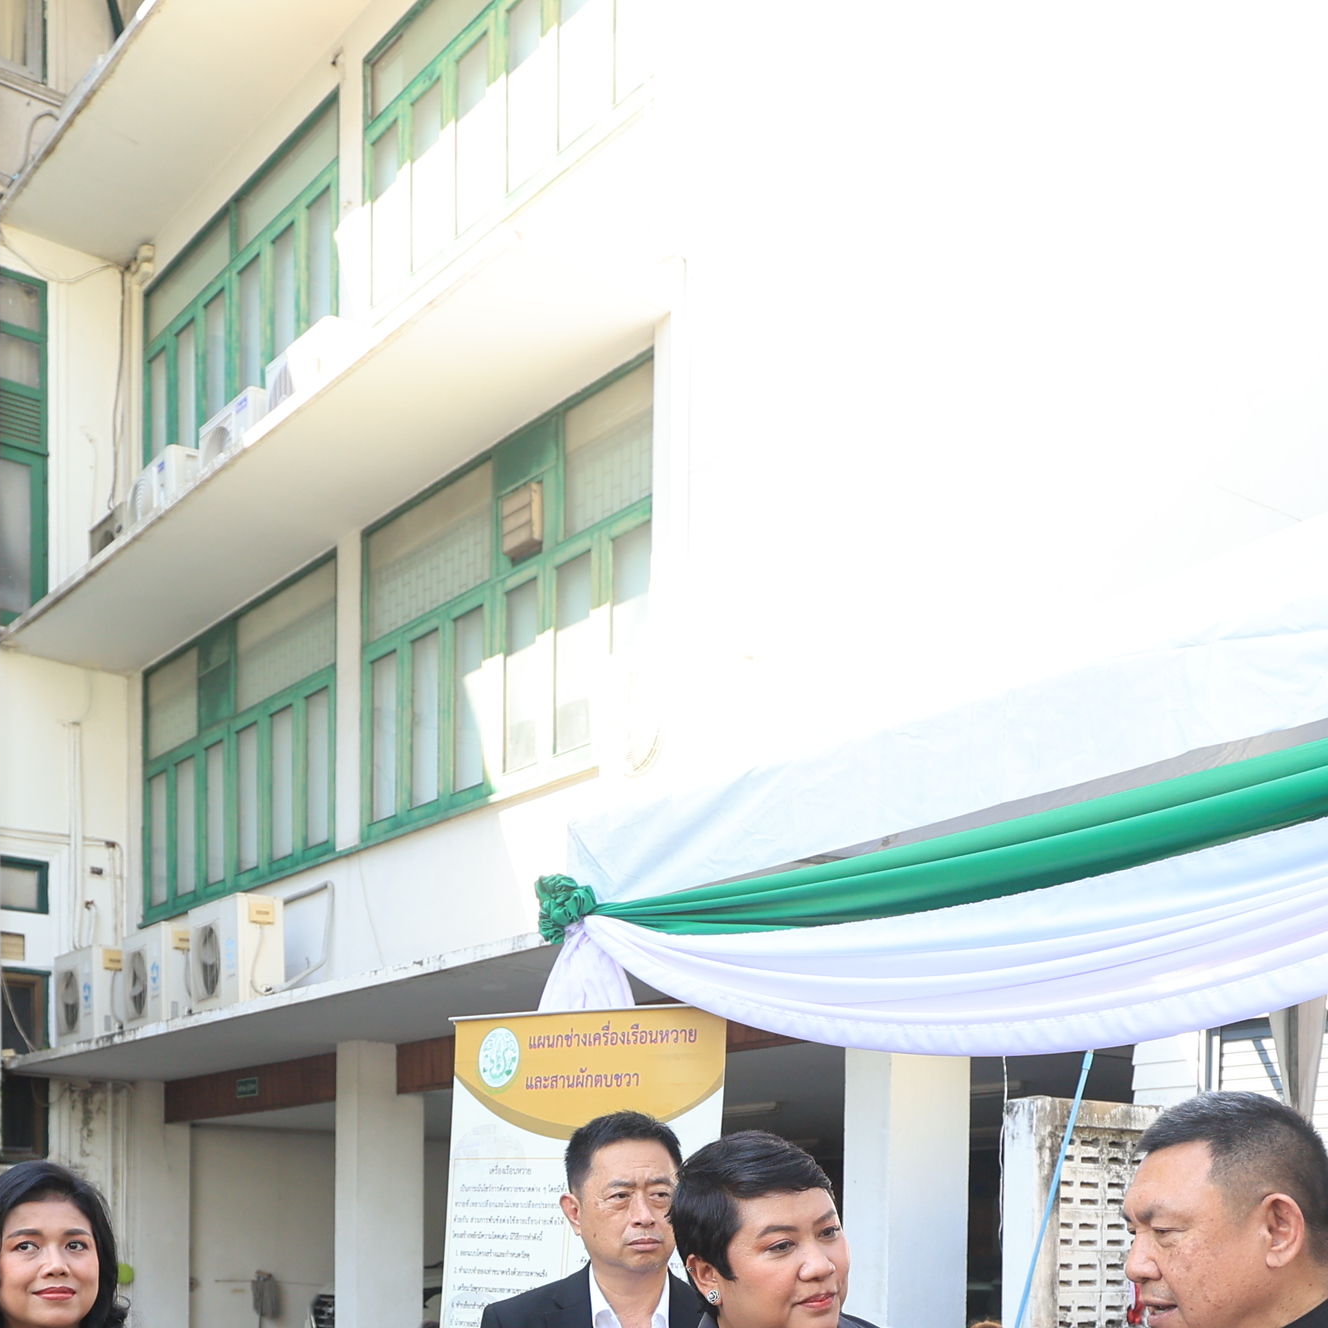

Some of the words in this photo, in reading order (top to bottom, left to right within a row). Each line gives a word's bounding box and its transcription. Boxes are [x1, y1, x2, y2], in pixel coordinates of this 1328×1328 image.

[528, 1020, 698, 1050] แผนกช่างเครื่องเรือนหวาย
[525, 1067, 640, 1091] และสานผักตบชวา
